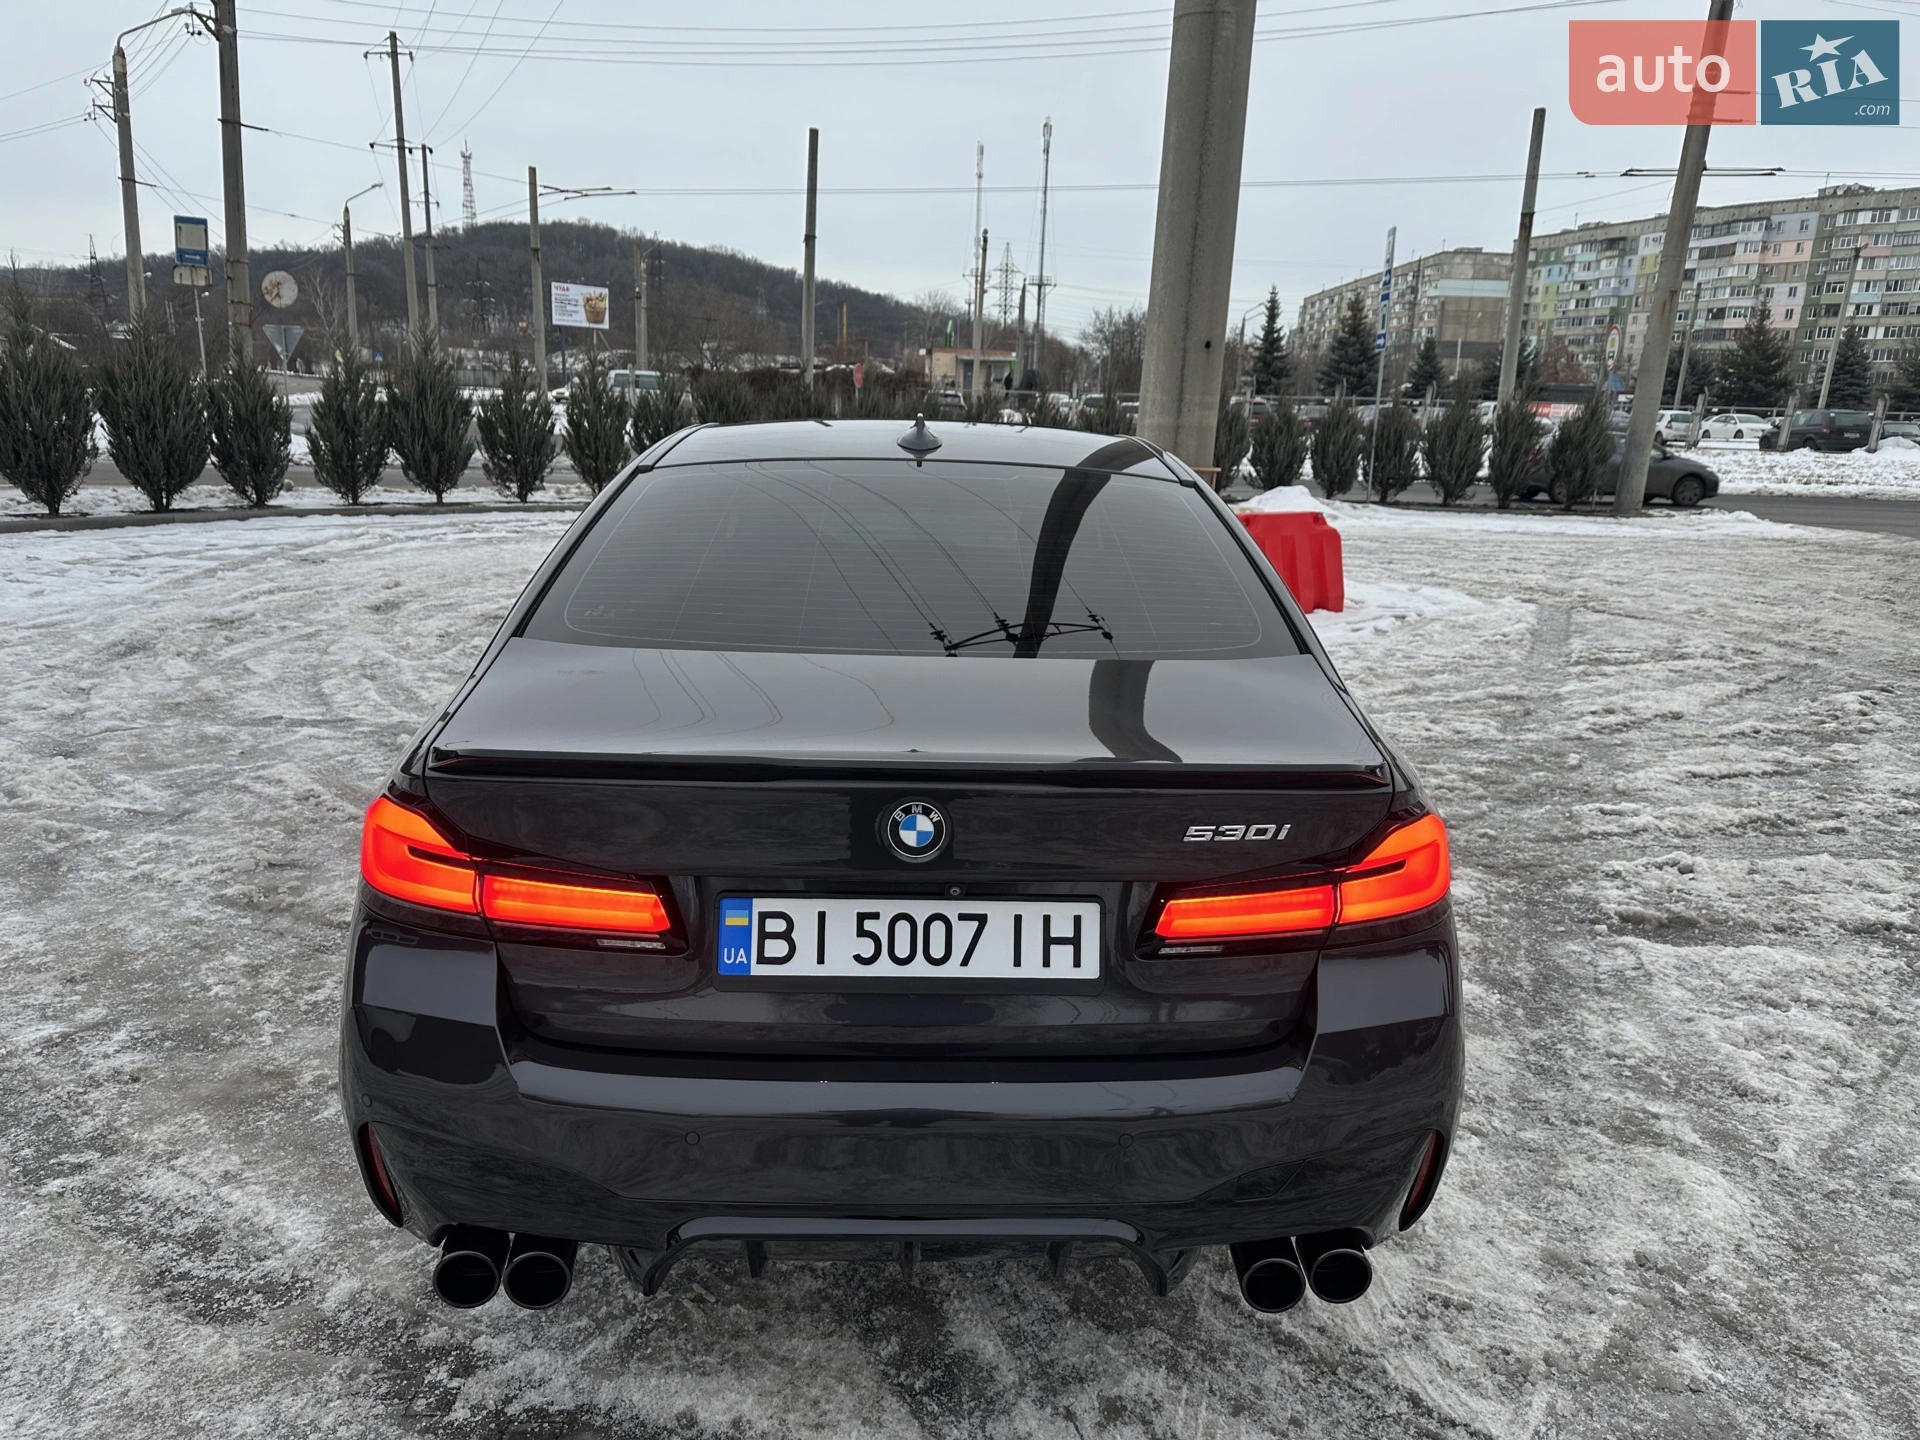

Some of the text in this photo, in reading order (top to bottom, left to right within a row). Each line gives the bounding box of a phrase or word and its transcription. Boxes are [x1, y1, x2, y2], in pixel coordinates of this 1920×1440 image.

[894, 804, 941, 823] BMW
[1183, 824, 1292, 842] 530i
[756, 910, 1082, 968] BI 5007 IH
[723, 947, 748, 965] UA
